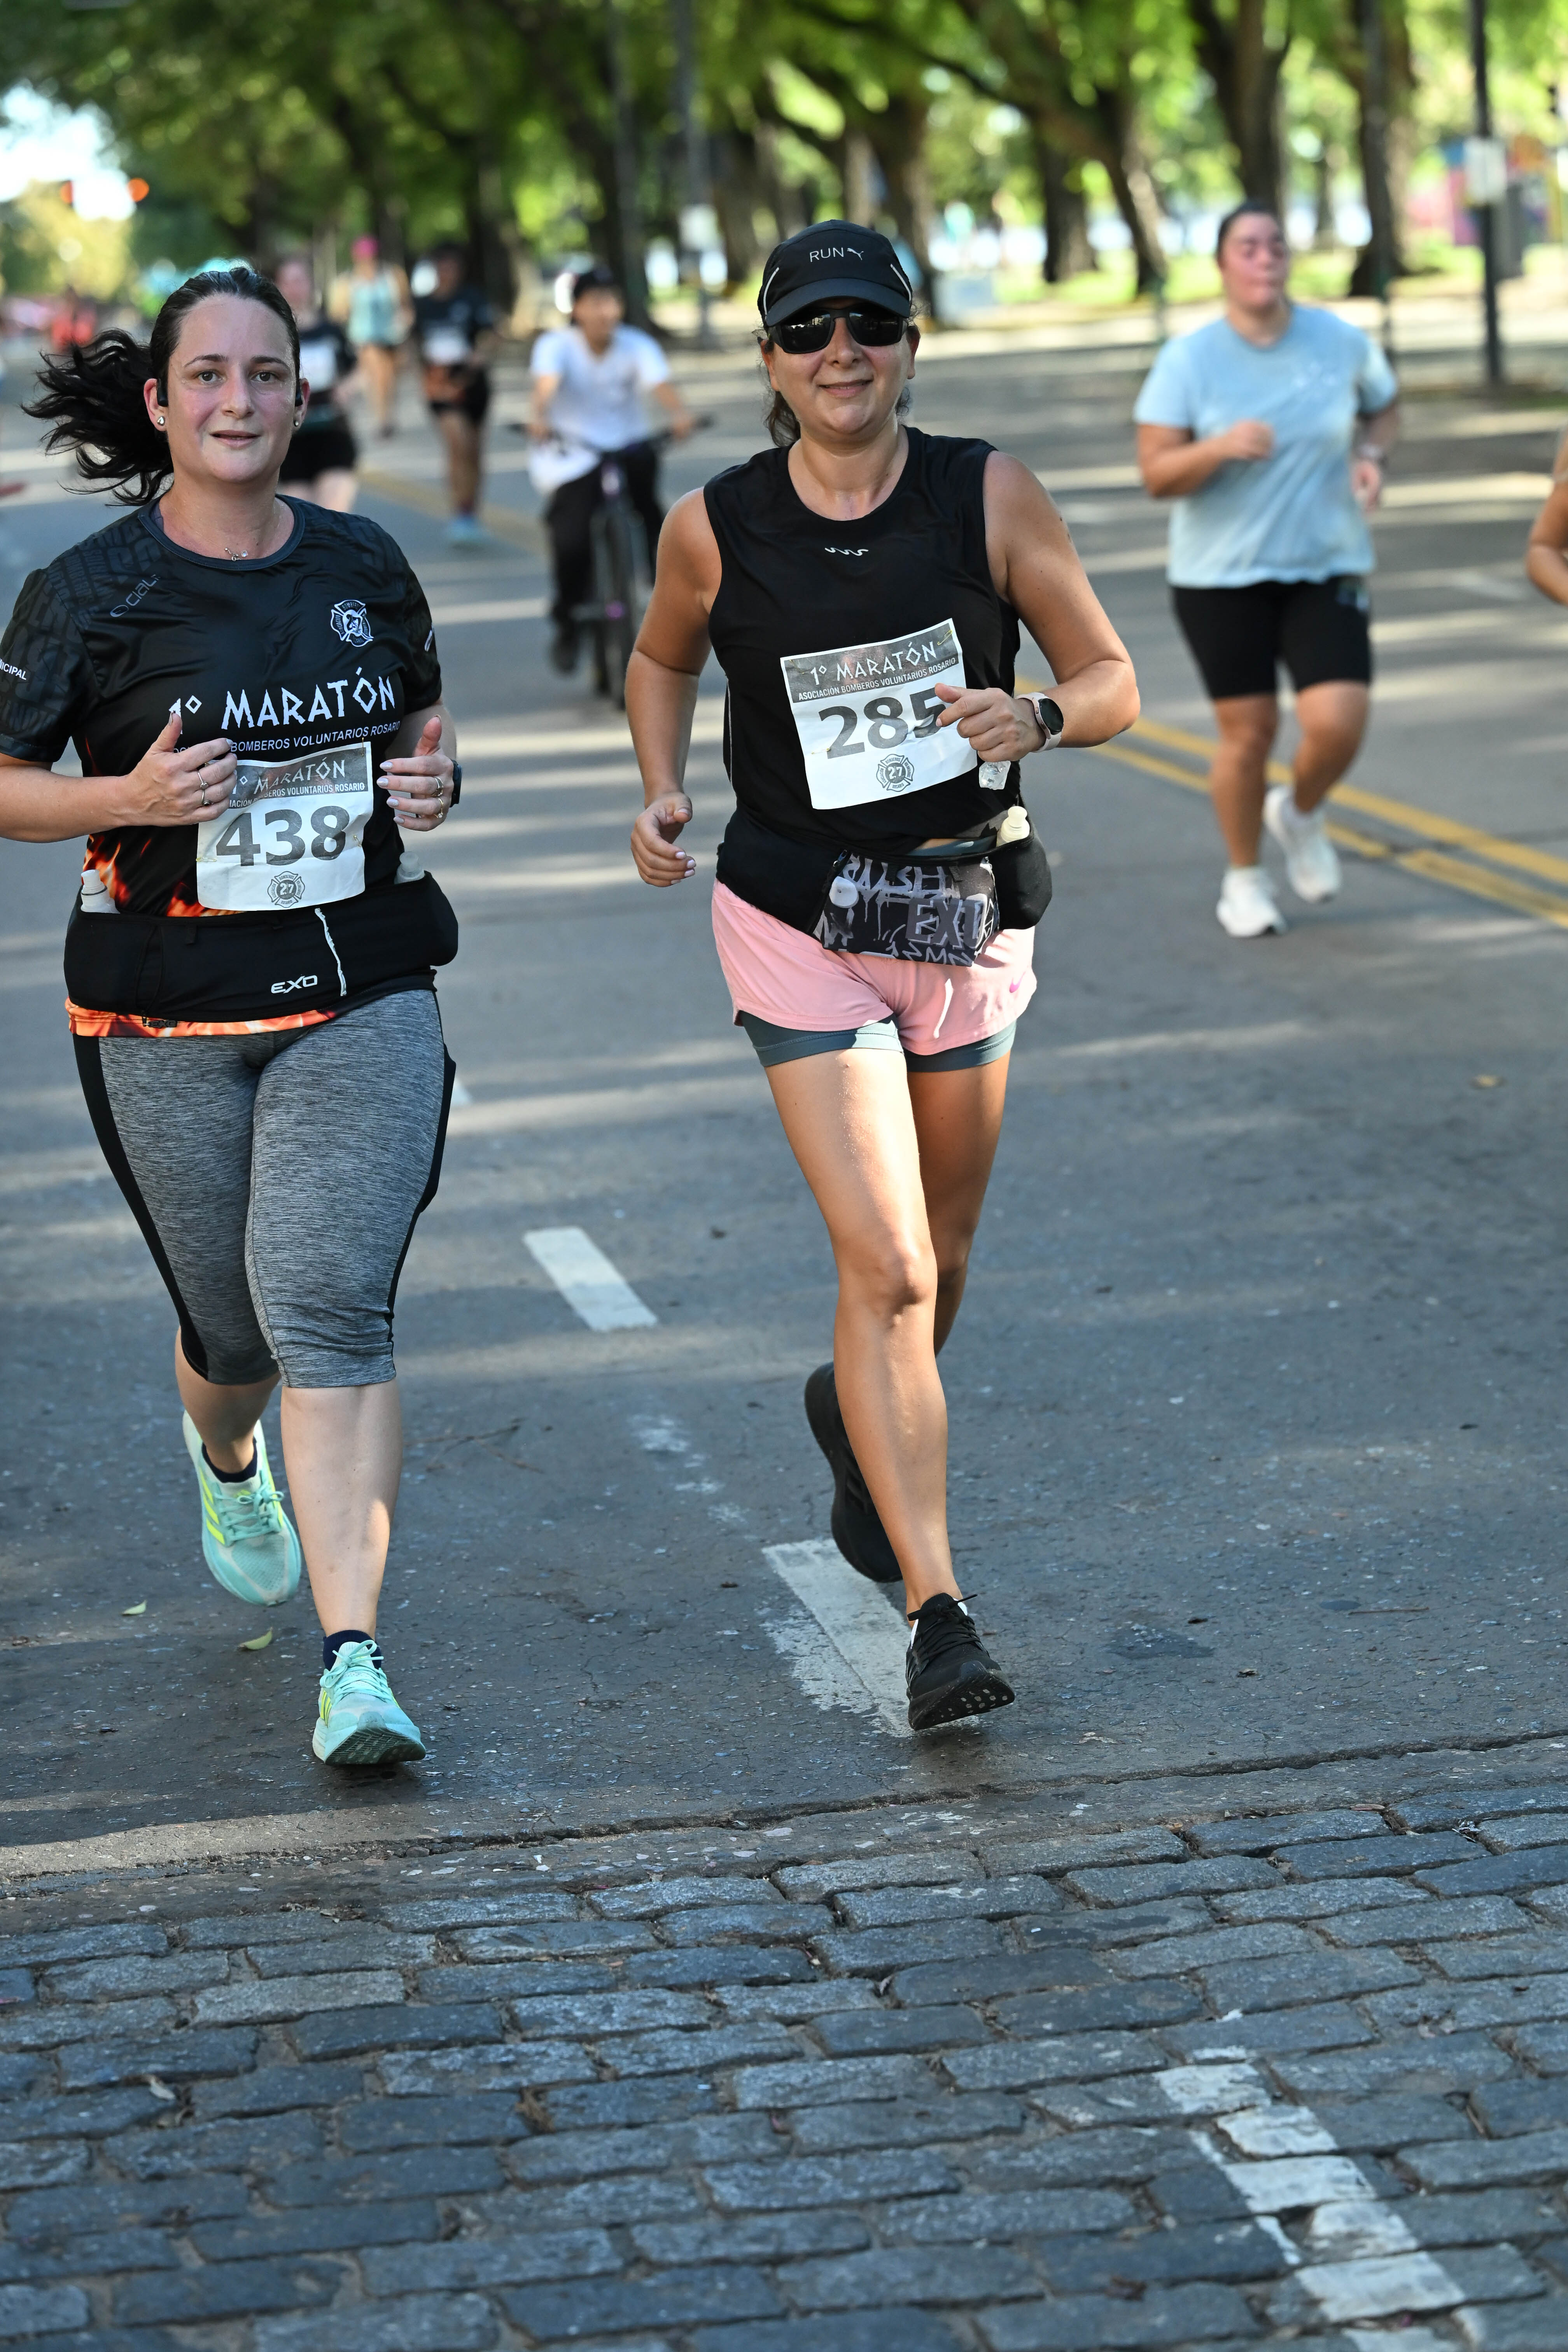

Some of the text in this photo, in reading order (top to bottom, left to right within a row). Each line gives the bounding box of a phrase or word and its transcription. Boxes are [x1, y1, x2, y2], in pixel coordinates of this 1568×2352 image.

[810, 247, 844, 262] RUN
[836, 640, 936, 681] MARATÓN
[798, 657, 956, 700] ASOCIACIÓN BOMBEROS VOLUNTARIOS ROSARIO
[221, 667, 395, 730] MARATÓN
[231, 721, 400, 752] BOMBEROS VOLUNTARIOS ROSARIO
[818, 687, 946, 759] 285
[254, 757, 345, 794] MARATÓN
[287, 784, 333, 795] VOLUNTARIOS
[335, 782, 365, 792] ROSARIO
[888, 766, 902, 779] 27
[216, 806, 350, 866] 438
[280, 883, 294, 895] 27
[271, 975, 317, 993] EXO
